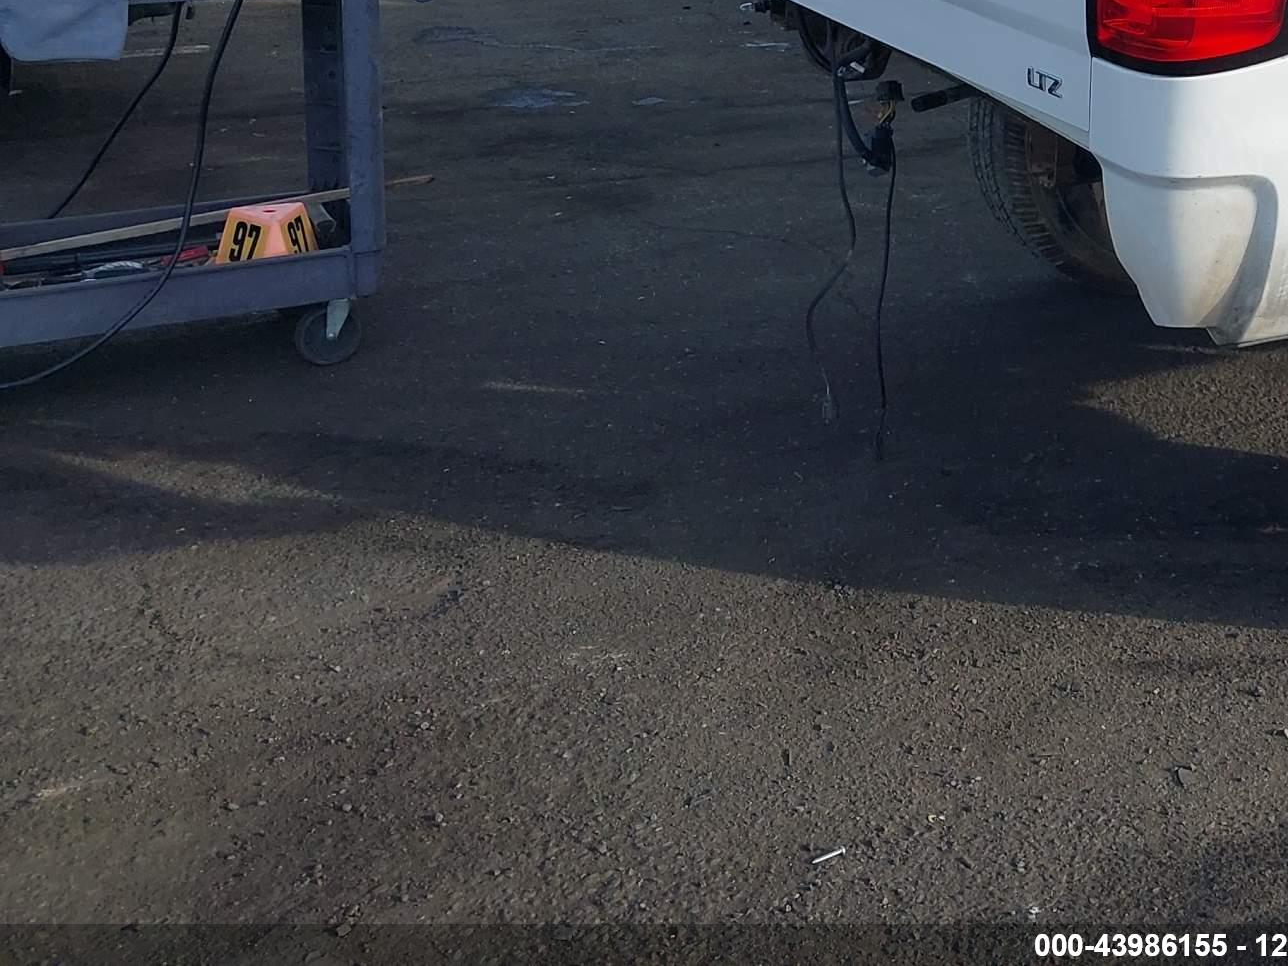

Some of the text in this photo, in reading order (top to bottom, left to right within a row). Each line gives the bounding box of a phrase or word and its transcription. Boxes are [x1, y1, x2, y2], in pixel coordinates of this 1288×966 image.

[1027, 67, 1062, 99] LTZ
[228, 221, 262, 262] 97
[287, 215, 310, 254] 97
